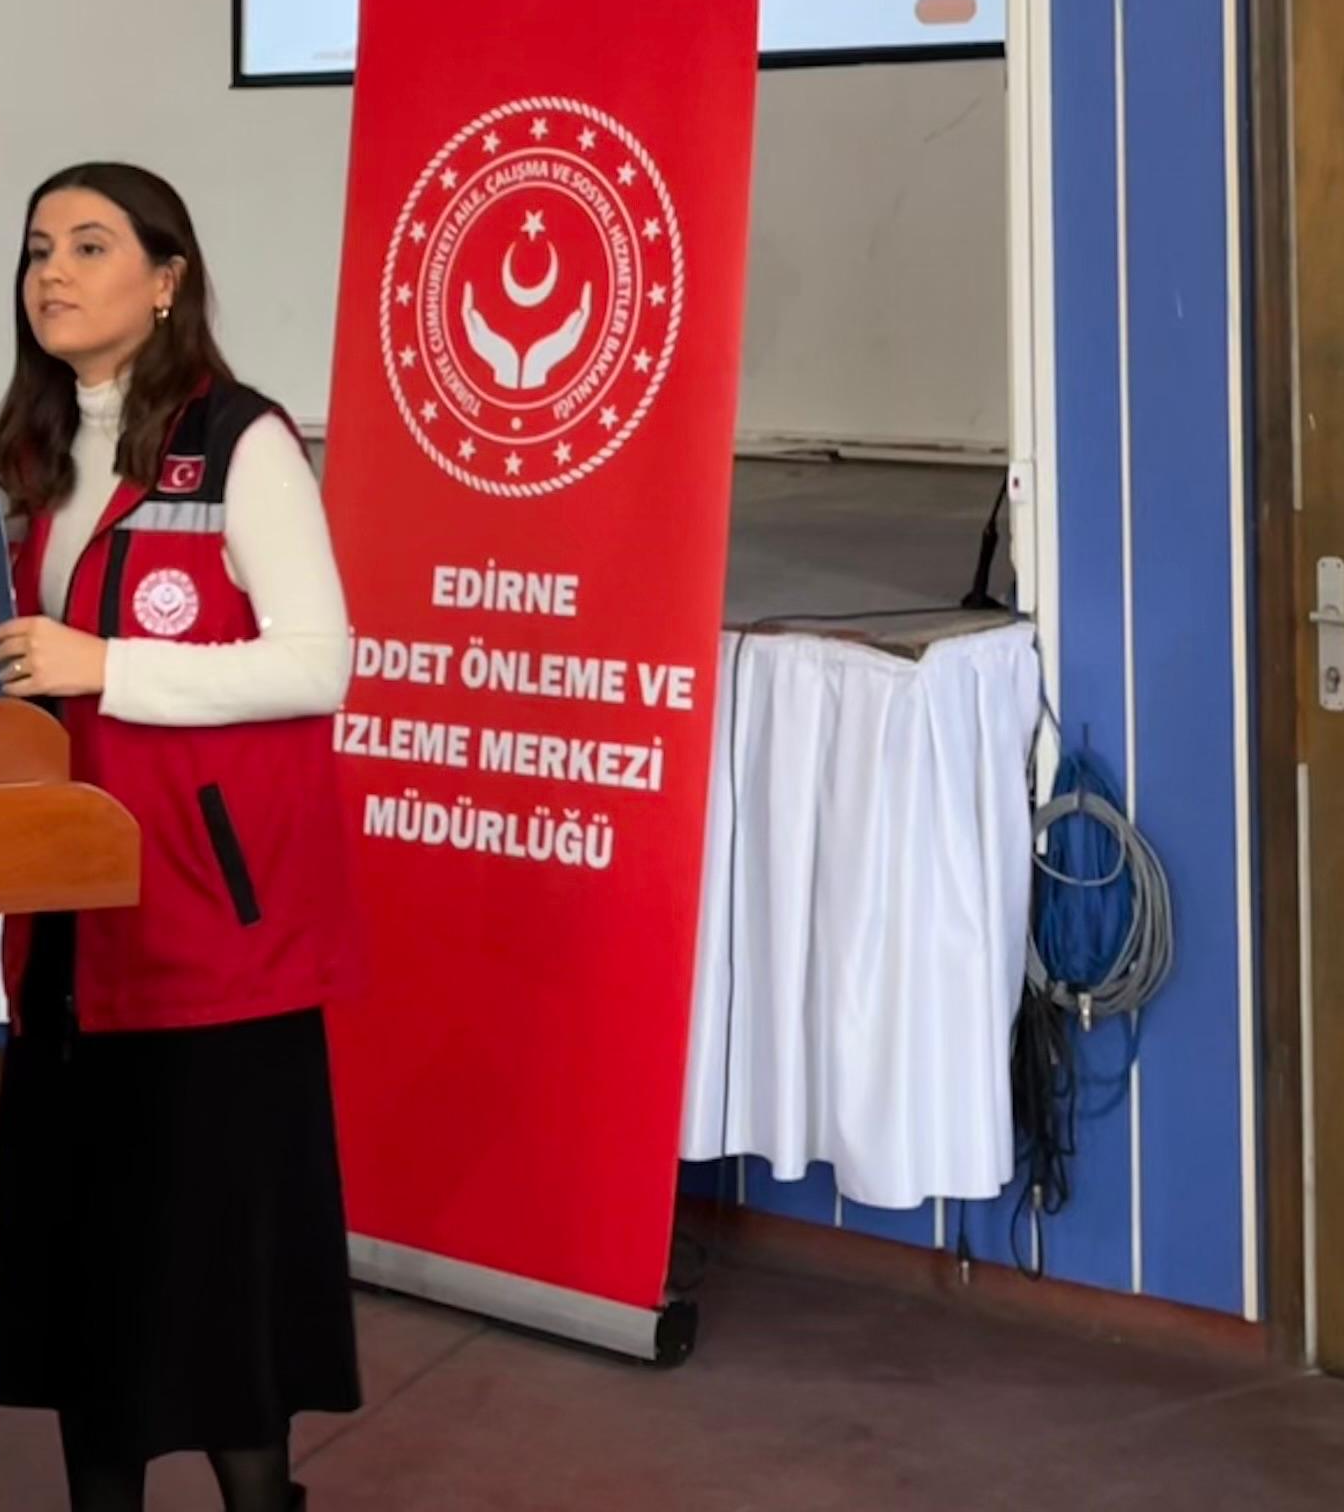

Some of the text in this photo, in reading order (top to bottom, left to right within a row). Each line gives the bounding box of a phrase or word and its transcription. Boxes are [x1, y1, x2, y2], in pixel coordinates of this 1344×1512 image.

[436, 351, 482, 417] TÜRKİYE
[484, 159, 549, 196] ÇALIŞMA
[552, 161, 573, 184] VE
[570, 170, 616, 228] SOSYAL
[432, 558, 579, 616] EDİRNE
[348, 625, 695, 710] İDDET ÖNLEME VE
[332, 703, 663, 791] İZLEME MERKEZİ
[362, 787, 614, 870] MÜDÜRLÜĞÜ
